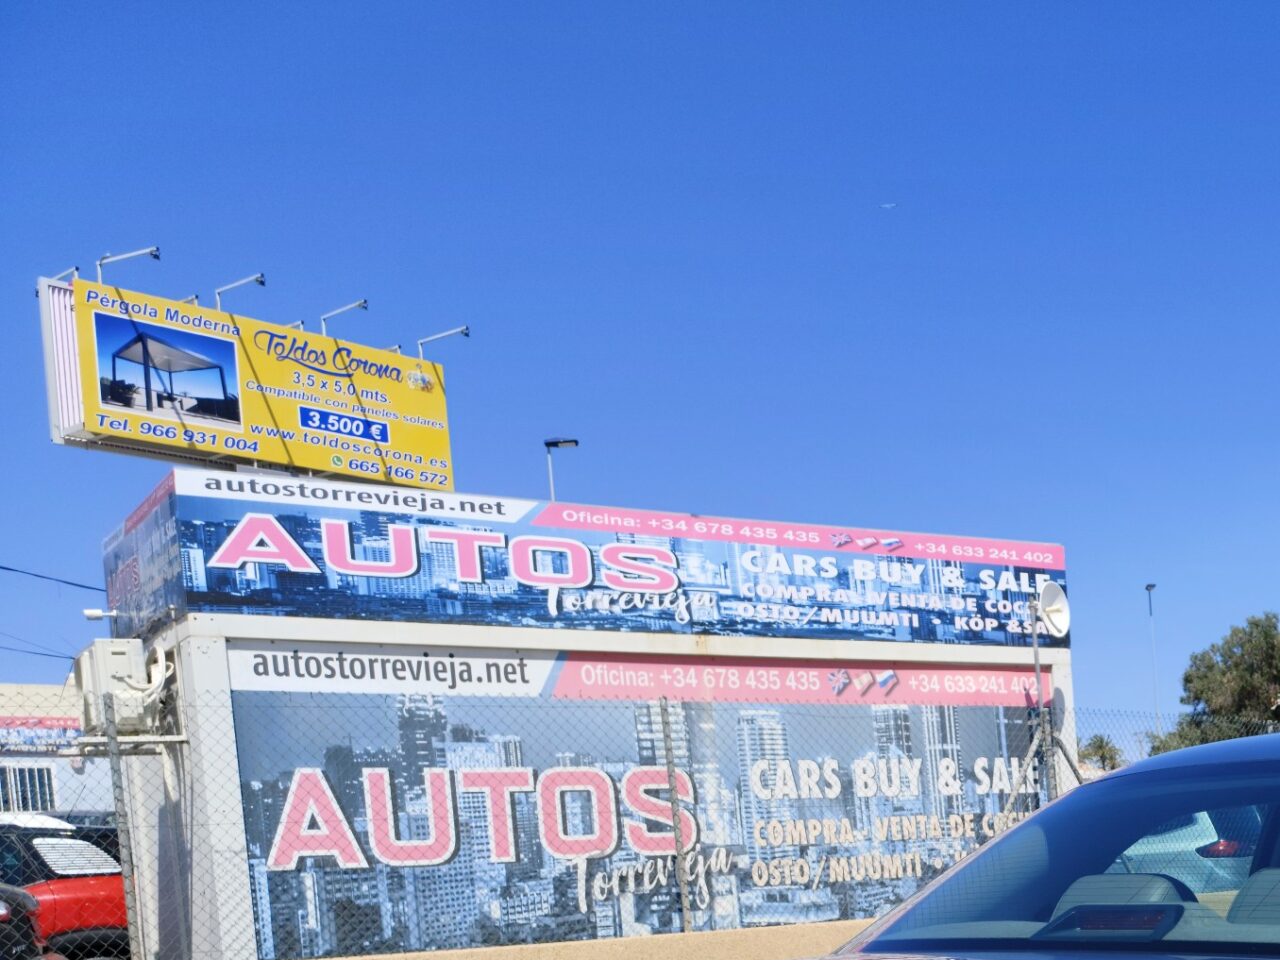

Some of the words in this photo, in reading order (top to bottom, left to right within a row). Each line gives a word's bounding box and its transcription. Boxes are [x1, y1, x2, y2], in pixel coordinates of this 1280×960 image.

[86, 290, 158, 318] Pérgola
[165, 307, 241, 337] Moderna
[254, 330, 327, 366] Toldos
[333, 347, 403, 383] Corona
[246, 380, 321, 404] Compatible
[325, 398, 348, 410] con
[352, 403, 399, 420] paneles
[403, 414, 445, 430] solares
[293, 371, 315, 388] 3,5
[320, 381, 328, 391] x
[334, 380, 356, 396] 5,0
[360, 387, 392, 404] mts.
[96, 414, 132, 432] Tel.
[140, 422, 177, 439] 966
[183, 429, 217, 446] 931
[224, 436, 259, 452] 004
[308, 411, 364, 436] 3.500
[370, 423, 383, 440] €
[250, 424, 448, 469] www.toldoscorona.es
[348, 459, 380, 474] 665
[387, 464, 415, 481] 166
[419, 471, 448, 485] 572
[204, 476, 507, 516] autostorrevieja.net
[562, 509, 640, 528] Oficina:
[648, 518, 688, 532] +34
[694, 521, 734, 536] 678
[740, 525, 778, 540] 435
[783, 529, 821, 543] 435
[206, 511, 683, 595] AUTOS
[741, 550, 838, 579] CARS
[853, 558, 926, 585] BUY
[942, 566, 965, 589] &
[914, 542, 947, 554] +34
[952, 545, 984, 558] 633
[989, 548, 1019, 561] 241
[1023, 552, 1054, 564] 402
[741, 582, 850, 604] COMPRA
[870, 591, 943, 613] VENTA
[950, 596, 978, 612] DE
[954, 613, 999, 632] KÖP
[253, 650, 530, 690] autostorrevieja.net
[580, 663, 655, 687] Oficina:
[660, 667, 698, 688] +34
[703, 668, 740, 690] 678
[745, 670, 781, 690] 435
[785, 671, 820, 691] 435
[908, 674, 940, 693] +34
[944, 675, 976, 693] 633
[980, 676, 1008, 694] 241
[1011, 677, 1038, 695] 402
[750, 758, 842, 799] CARS
[854, 757, 922, 798] BUY
[939, 757, 962, 795] &
[267, 766, 698, 871] AUTOS
[754, 818, 854, 847] COMPRA
[874, 814, 942, 841] VENTA
[949, 814, 976, 838] DE
